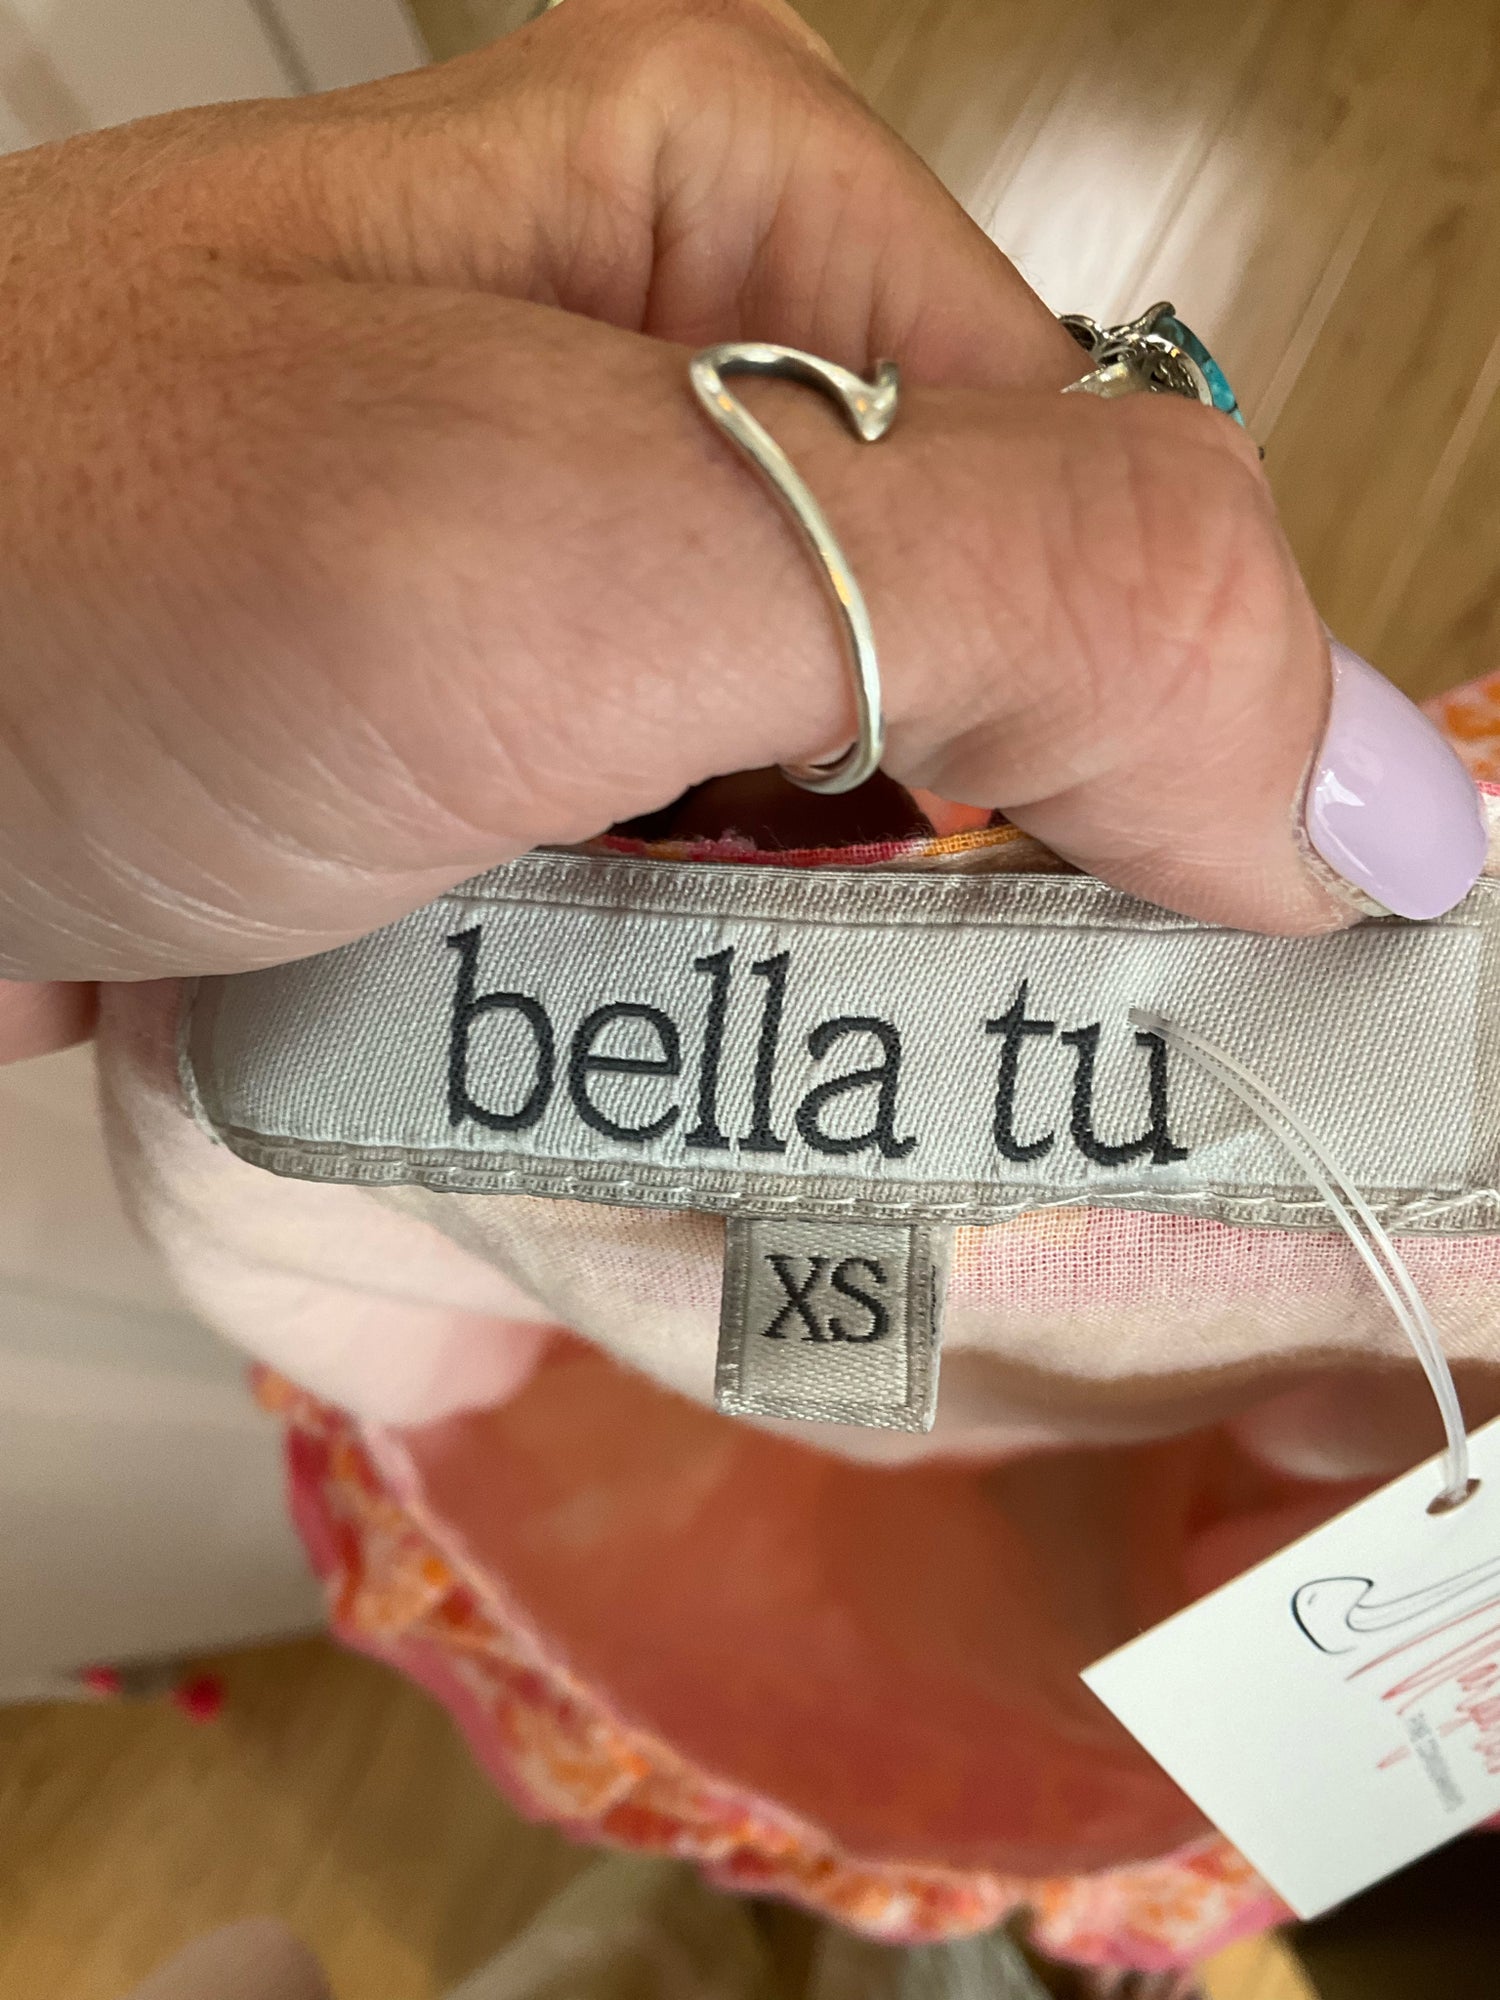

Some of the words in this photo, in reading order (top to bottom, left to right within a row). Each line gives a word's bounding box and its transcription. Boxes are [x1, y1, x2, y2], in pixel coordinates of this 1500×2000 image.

[446, 925, 915, 1159] bella
[985, 979, 1187, 1165] tu
[761, 1253, 890, 1343] XS
